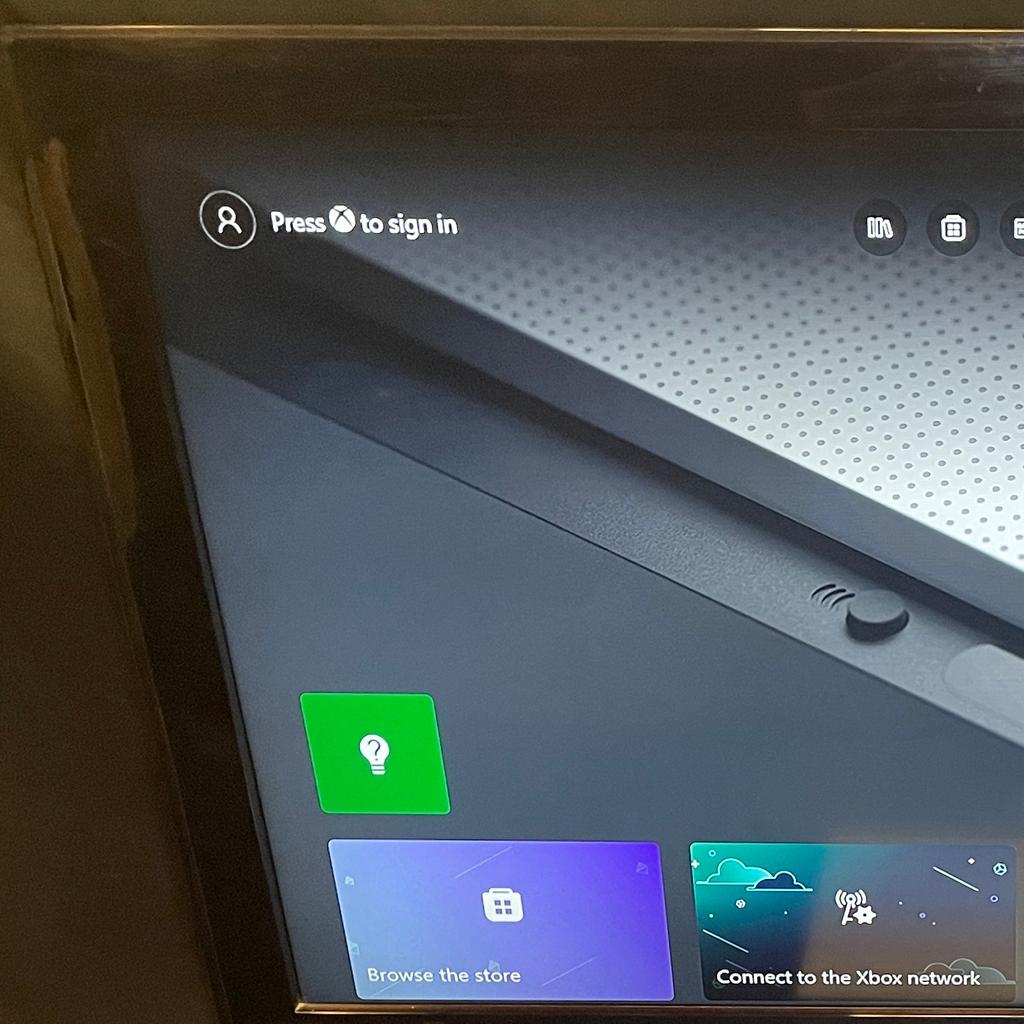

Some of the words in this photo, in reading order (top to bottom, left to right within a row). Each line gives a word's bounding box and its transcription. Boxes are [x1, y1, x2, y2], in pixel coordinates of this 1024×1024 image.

[271, 210, 327, 233] Press
[360, 213, 384, 233] to
[388, 213, 432, 240] sign
[437, 213, 459, 235] in
[367, 967, 434, 984] Browse
[439, 967, 469, 984] the
[473, 968, 521, 984] store
[716, 968, 793, 986] Connect
[797, 970, 815, 986] to
[821, 969, 851, 986] the
[856, 969, 903, 986] Xbox
[907, 969, 981, 986] network
